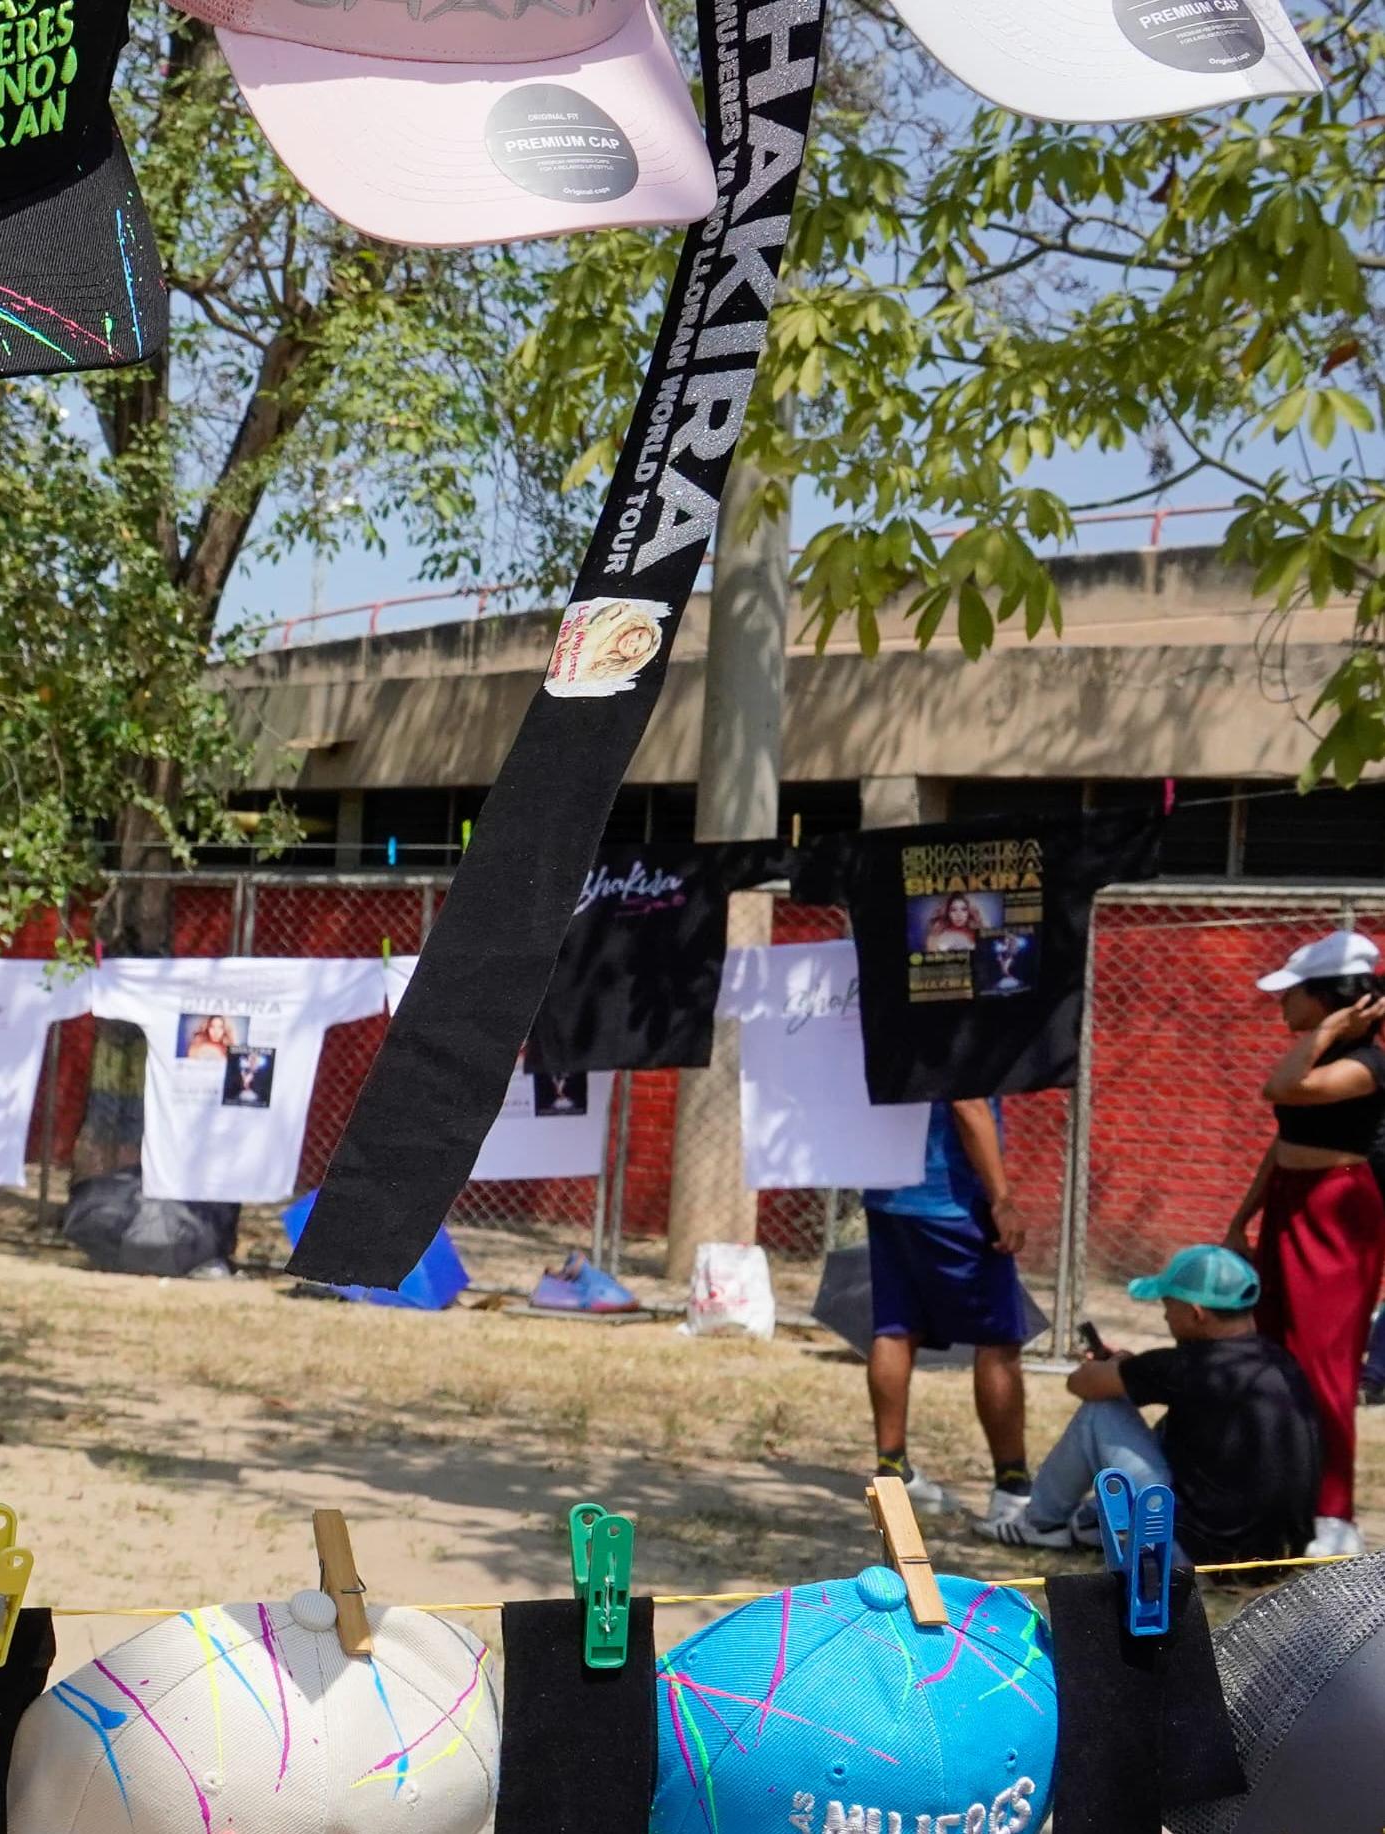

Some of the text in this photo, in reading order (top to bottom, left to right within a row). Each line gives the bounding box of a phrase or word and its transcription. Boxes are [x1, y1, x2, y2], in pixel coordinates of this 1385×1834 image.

[1138, 0, 1214, 29] PREMIUM
[504, 135, 620, 152] PREMIUM CAP
[633, 0, 822, 576] HAKIRA
[666, 247, 717, 370] LLORAN
[633, 373, 684, 485] WORLD
[603, 492, 640, 575] TOUR
